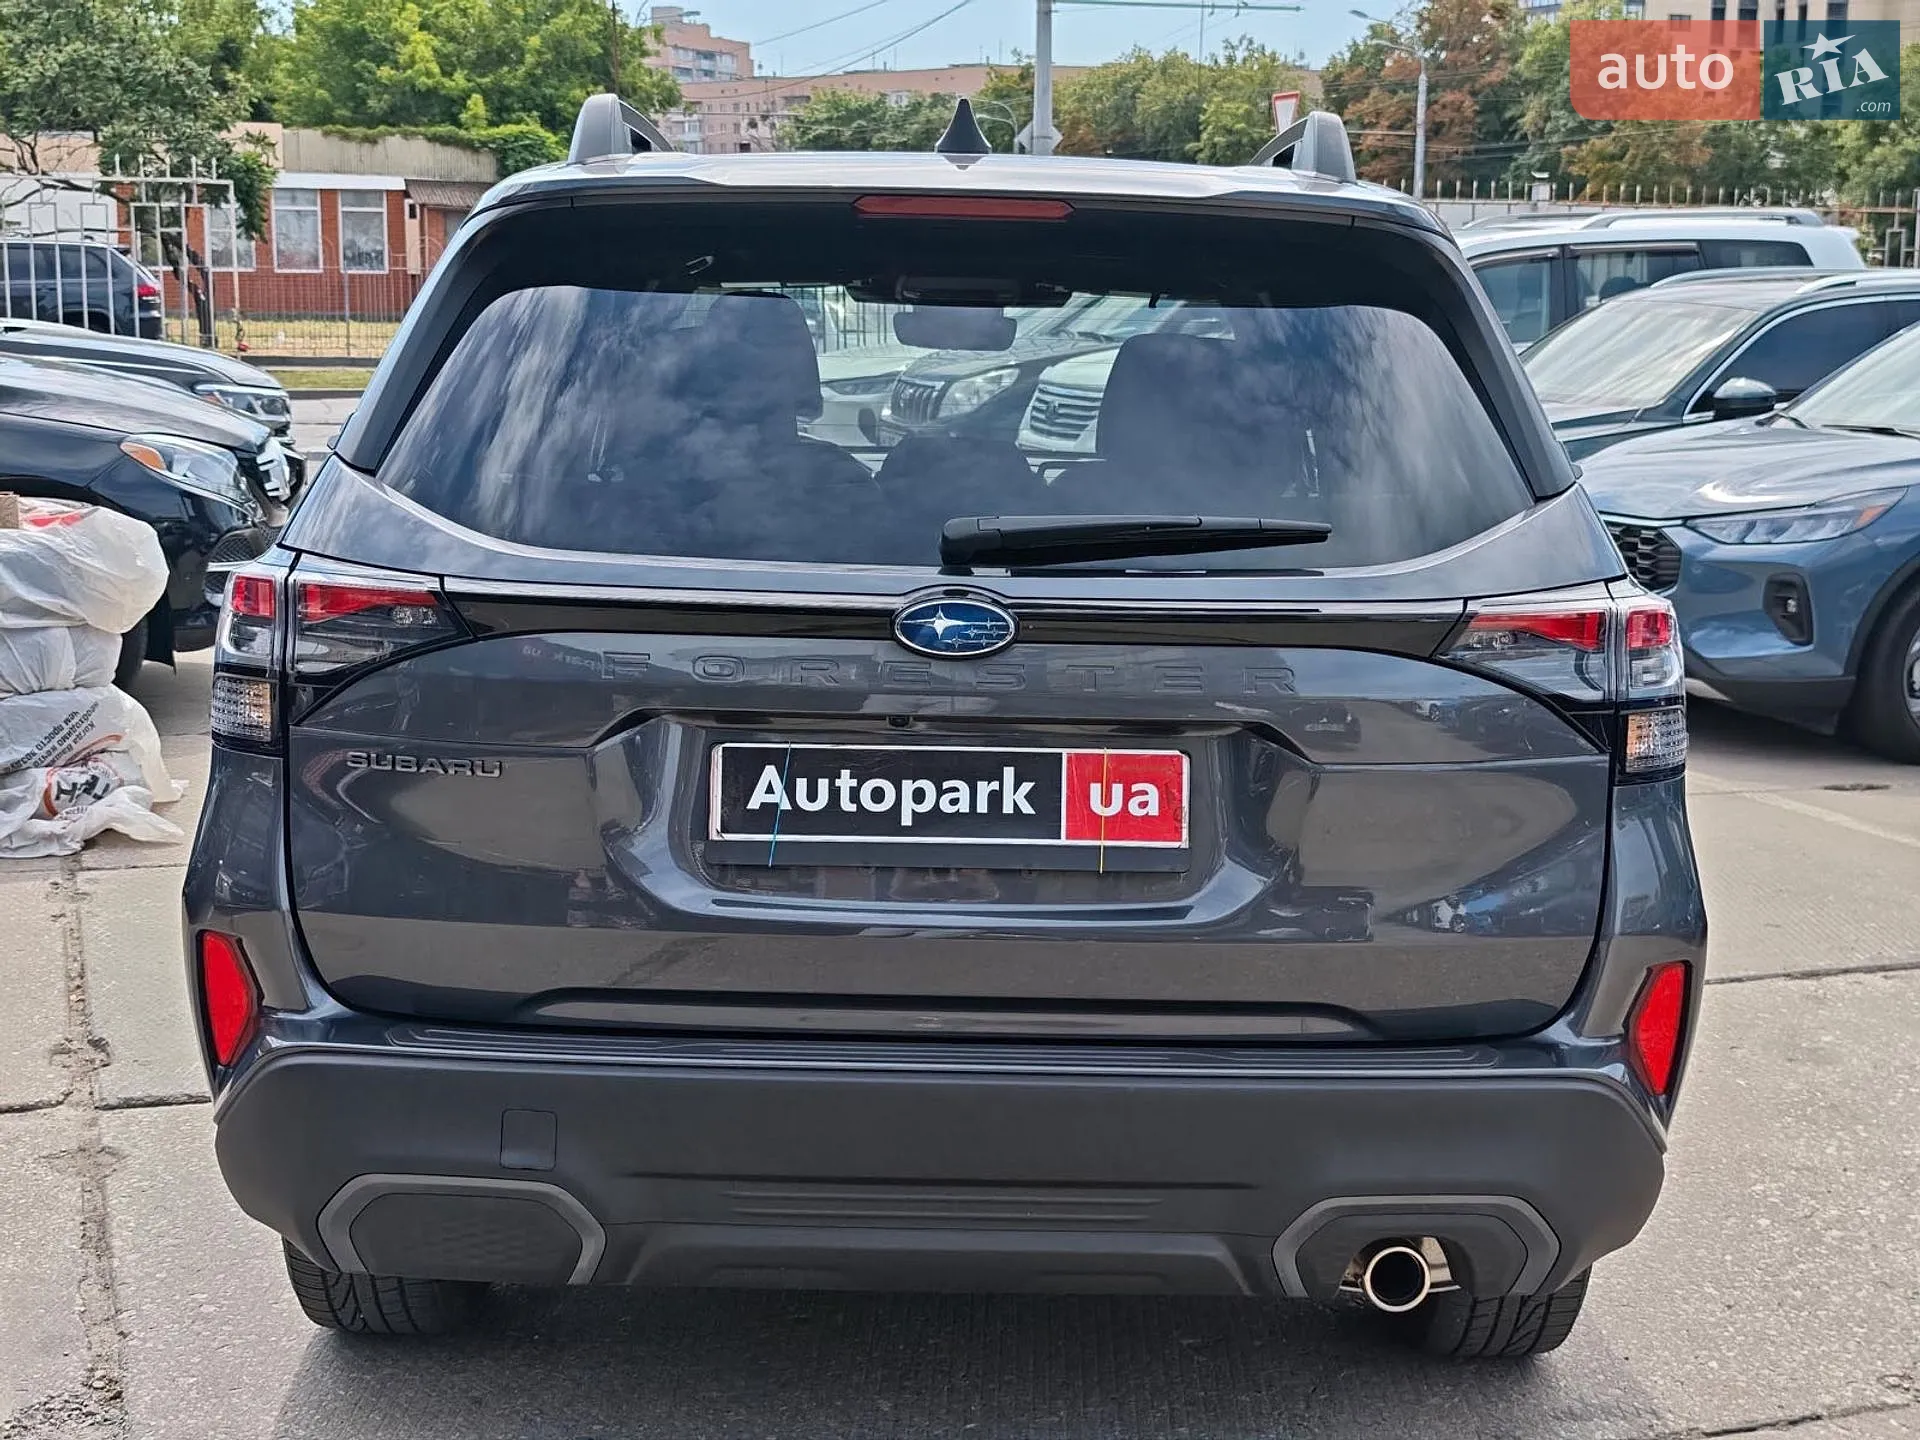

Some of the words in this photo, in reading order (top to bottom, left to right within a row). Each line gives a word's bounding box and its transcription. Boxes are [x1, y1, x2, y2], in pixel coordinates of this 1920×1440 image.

[600, 651, 1297, 694] FORESTER
[347, 751, 502, 778] SUBARU
[746, 765, 1036, 826] Autopark
[1089, 779, 1160, 817] ua
